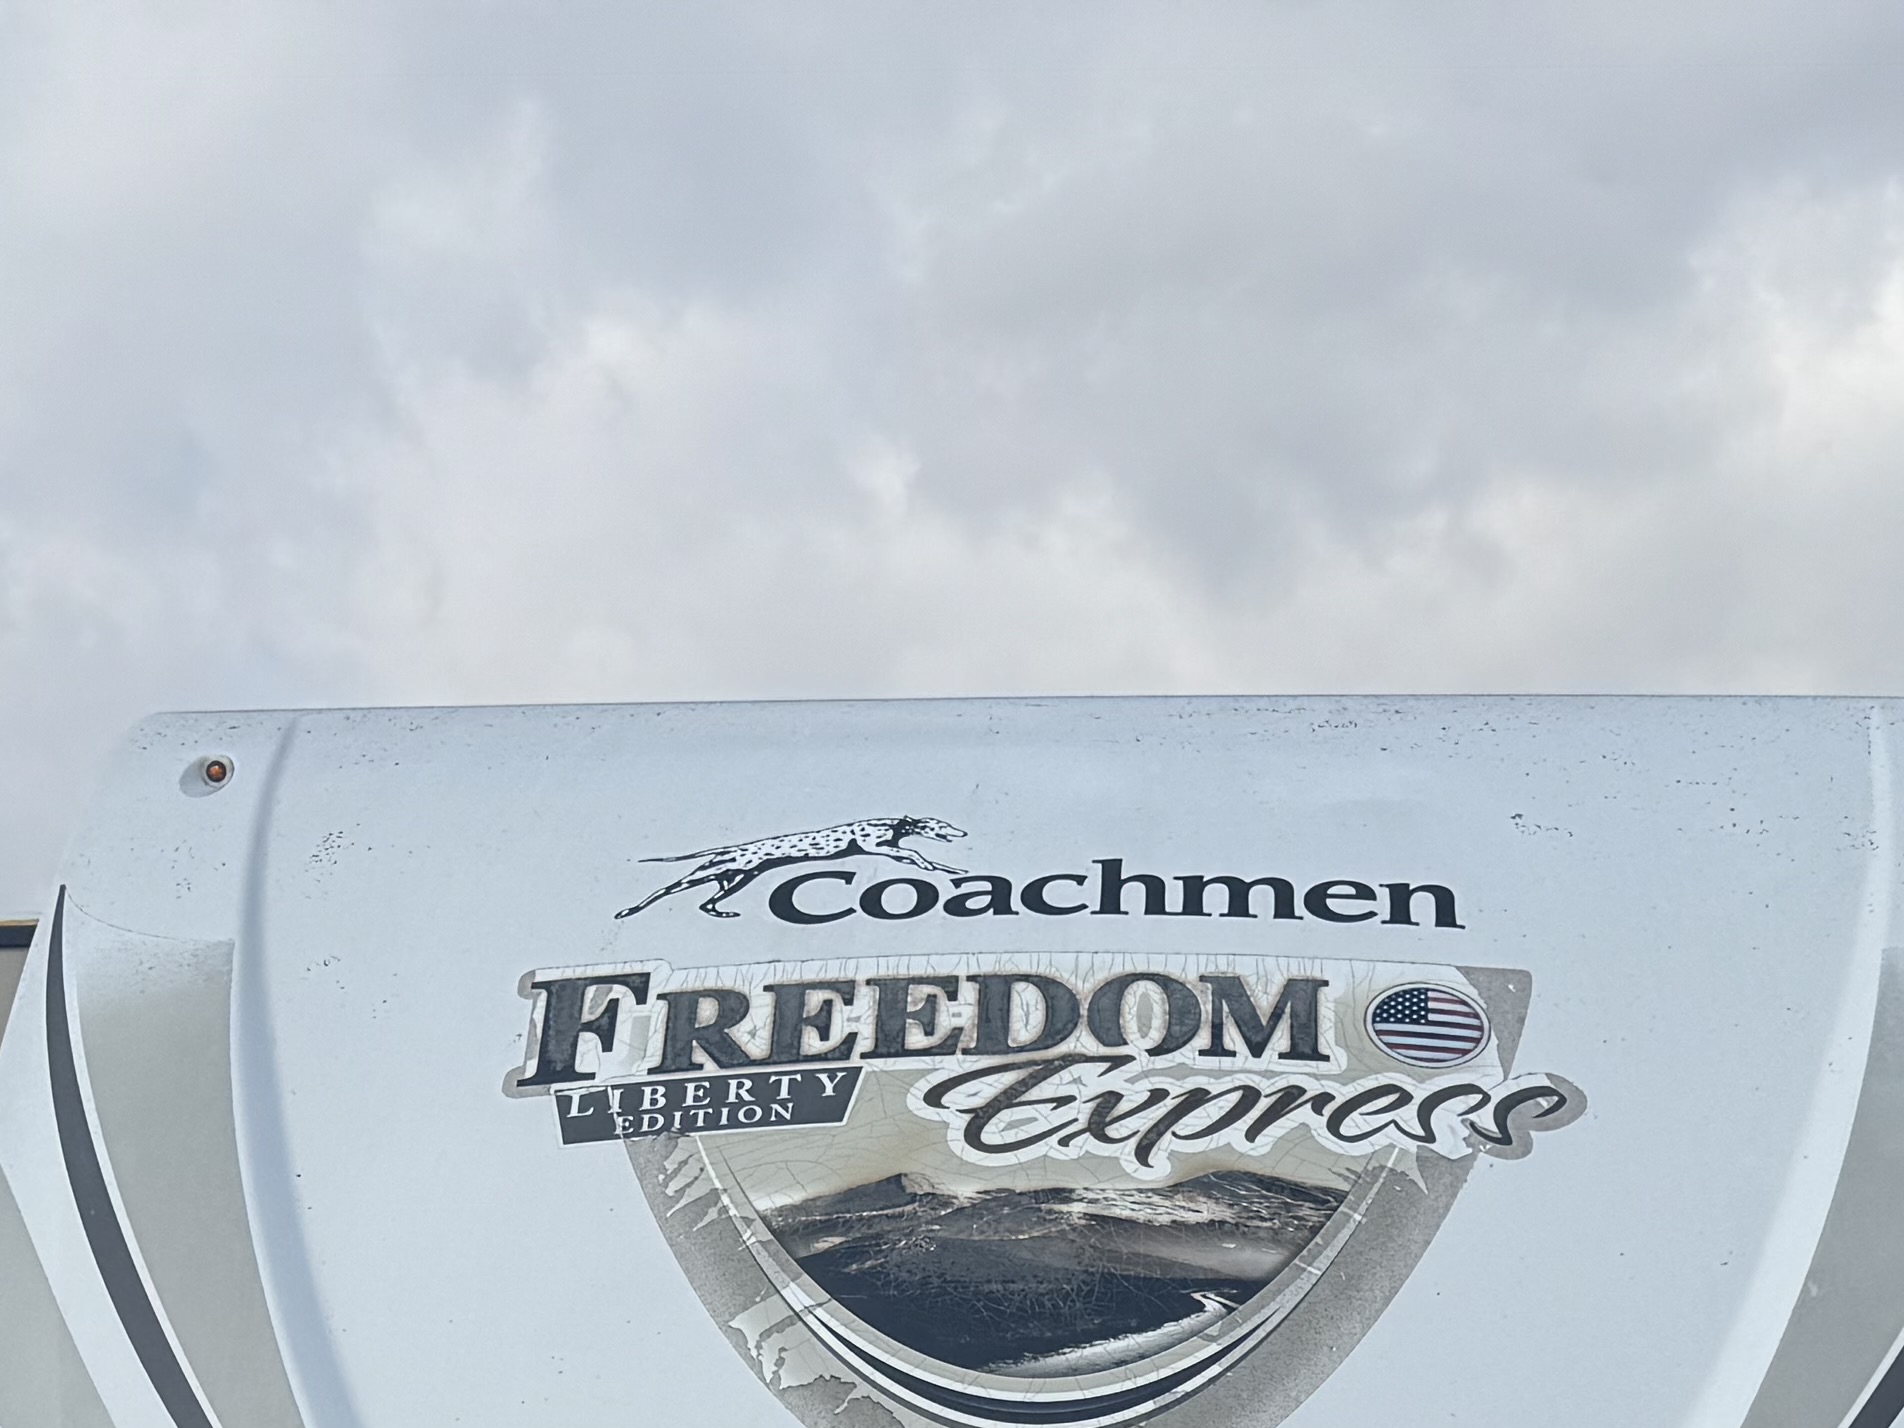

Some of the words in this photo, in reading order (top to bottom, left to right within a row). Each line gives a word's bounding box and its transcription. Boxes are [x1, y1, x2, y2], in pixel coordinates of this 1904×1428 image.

[768, 857, 1466, 930] Coachmen
[516, 970, 1331, 1088] FREEDOM
[565, 1071, 846, 1119] LIBERTY
[613, 1101, 794, 1136] EDITION
[922, 1054, 1568, 1168] Express
